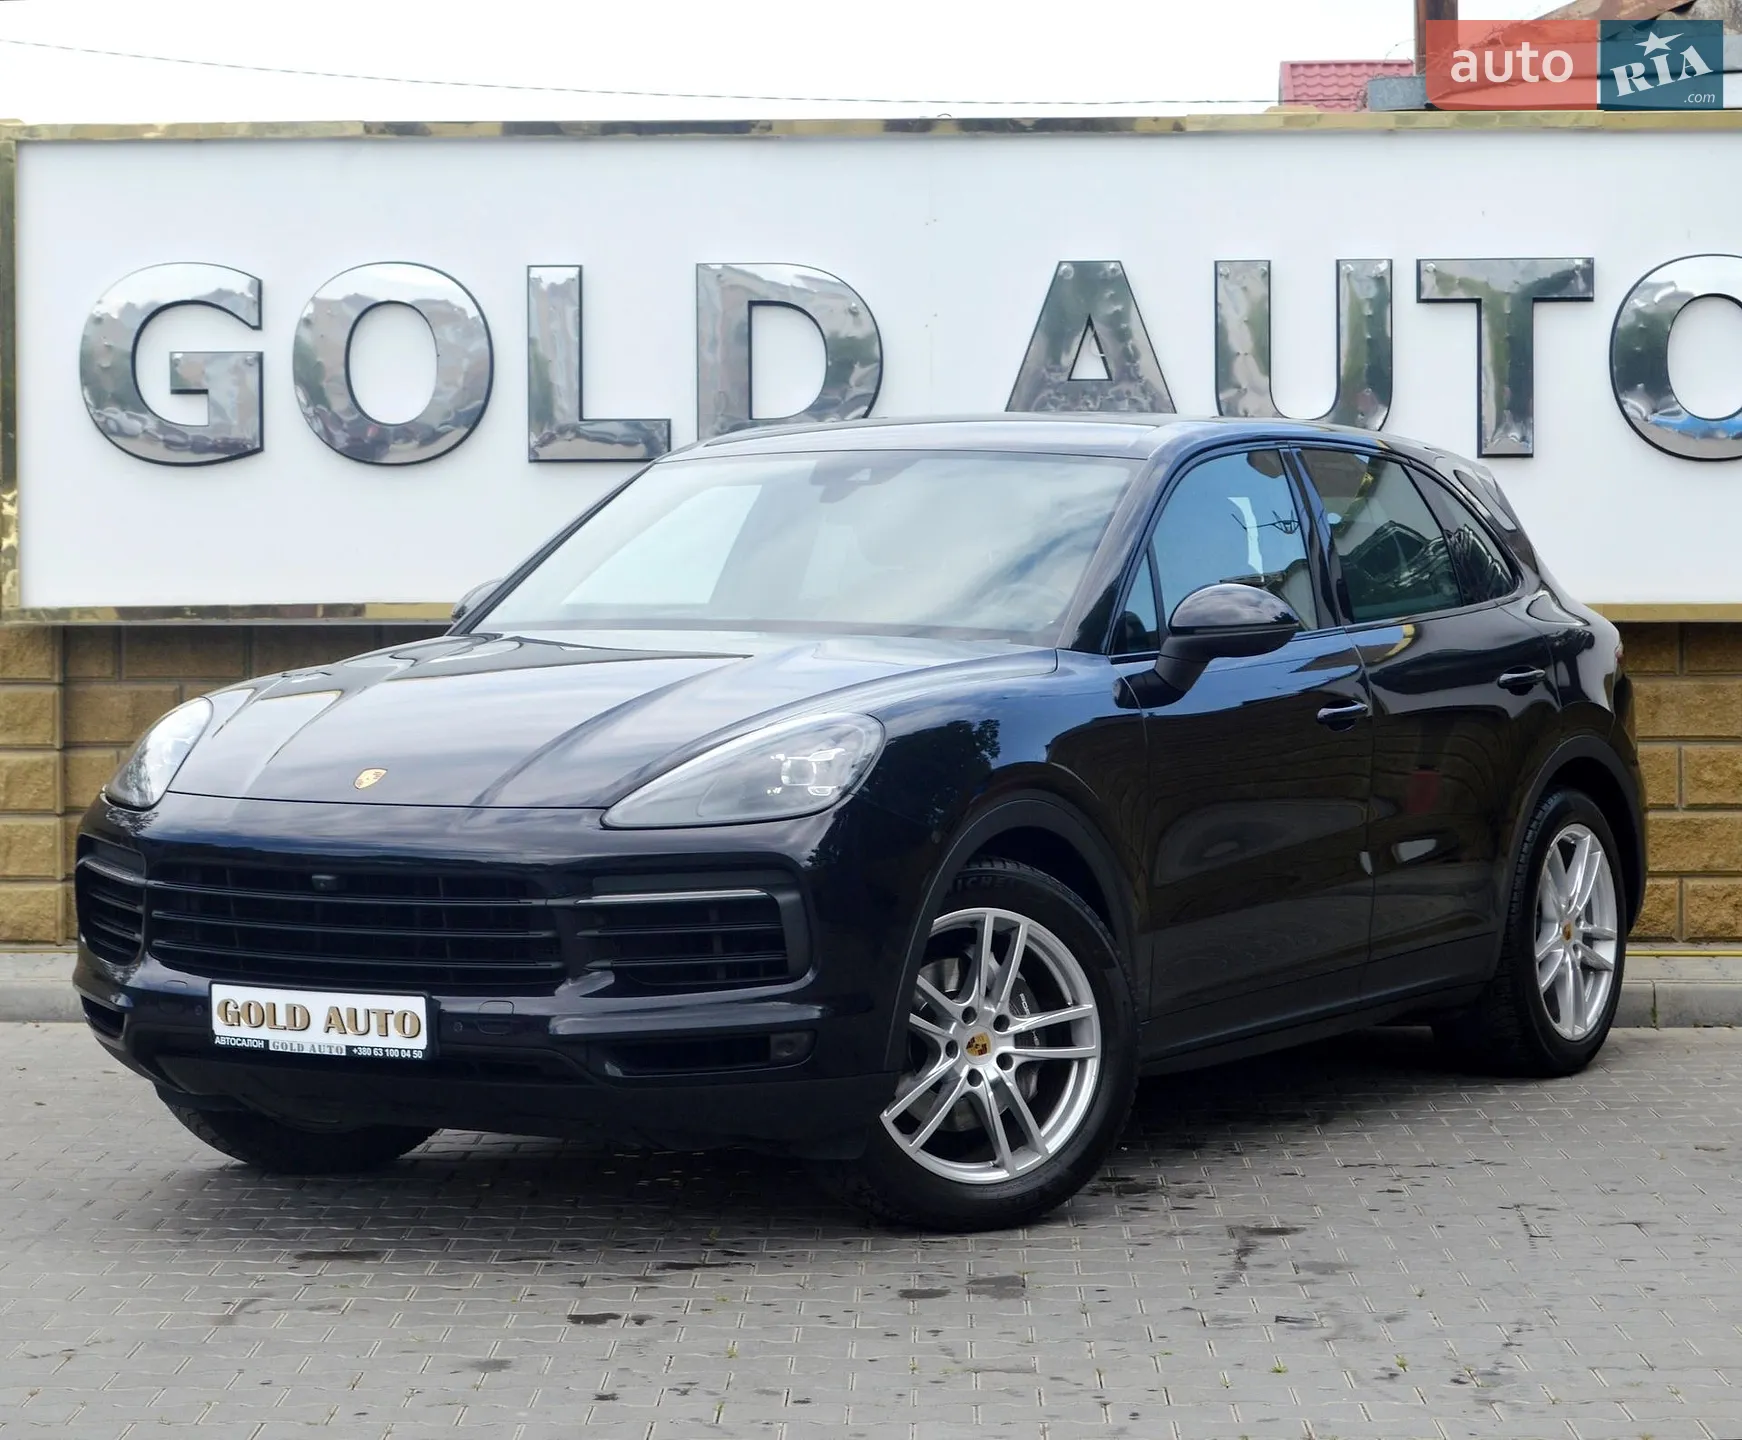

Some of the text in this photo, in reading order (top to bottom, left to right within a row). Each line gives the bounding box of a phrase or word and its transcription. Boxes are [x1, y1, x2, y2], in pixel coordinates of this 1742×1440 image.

[79, 254, 1742, 467] GOLD AUTO
[216, 998, 421, 1038] GOLD AUTO
[214, 1036, 265, 1049] АВТОСАЛОН
[272, 1041, 423, 1059] GOLD AUTO +380 63 100 04 50
